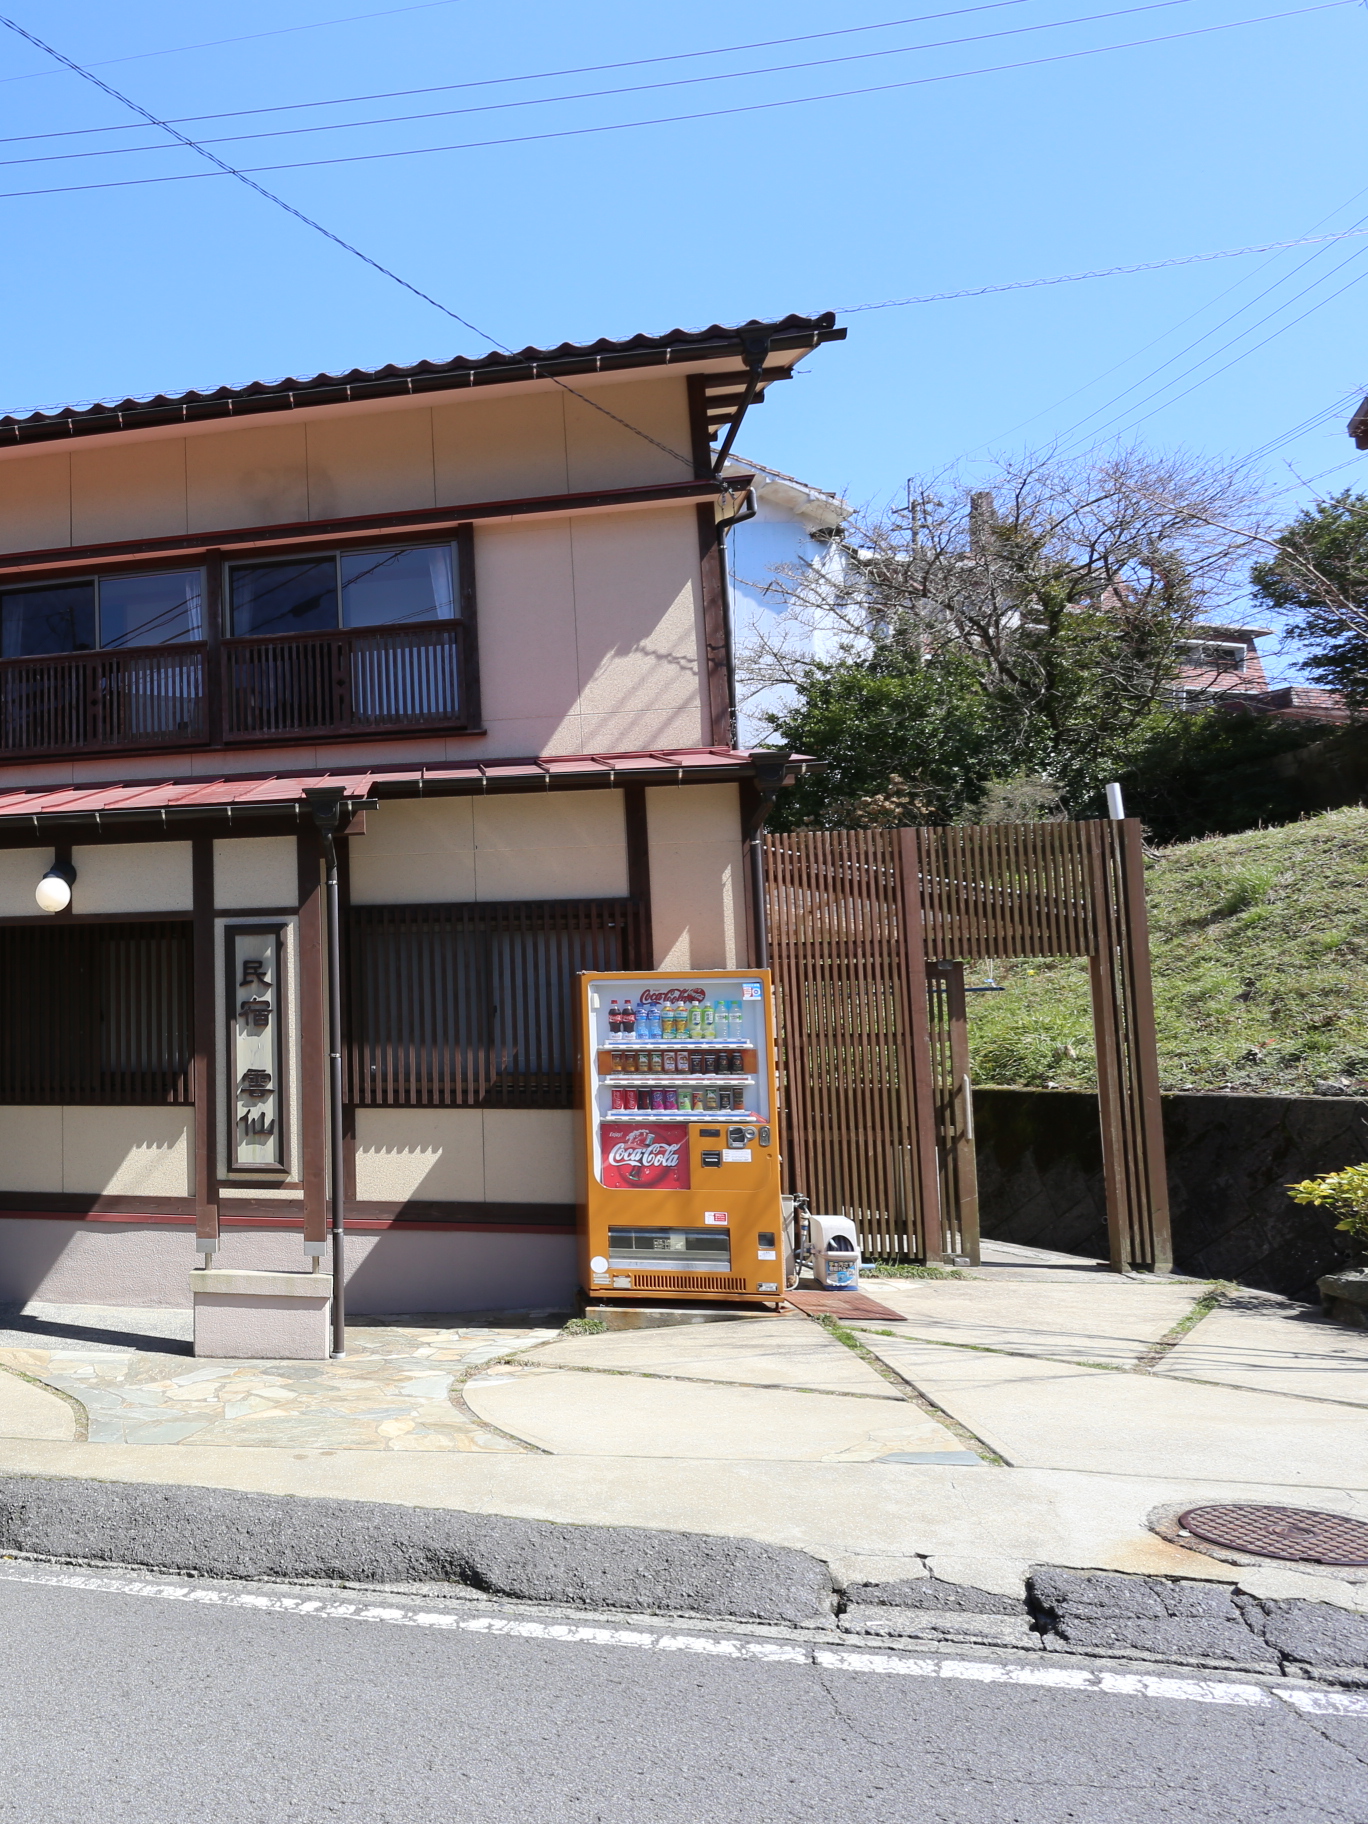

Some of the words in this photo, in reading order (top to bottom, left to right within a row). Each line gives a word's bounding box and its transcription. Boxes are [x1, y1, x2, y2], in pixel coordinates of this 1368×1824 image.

[238, 960, 273, 1028] 民宿
[237, 1068, 275, 1137] 雲仙
[608, 1142, 681, 1167] Coca-Cola
